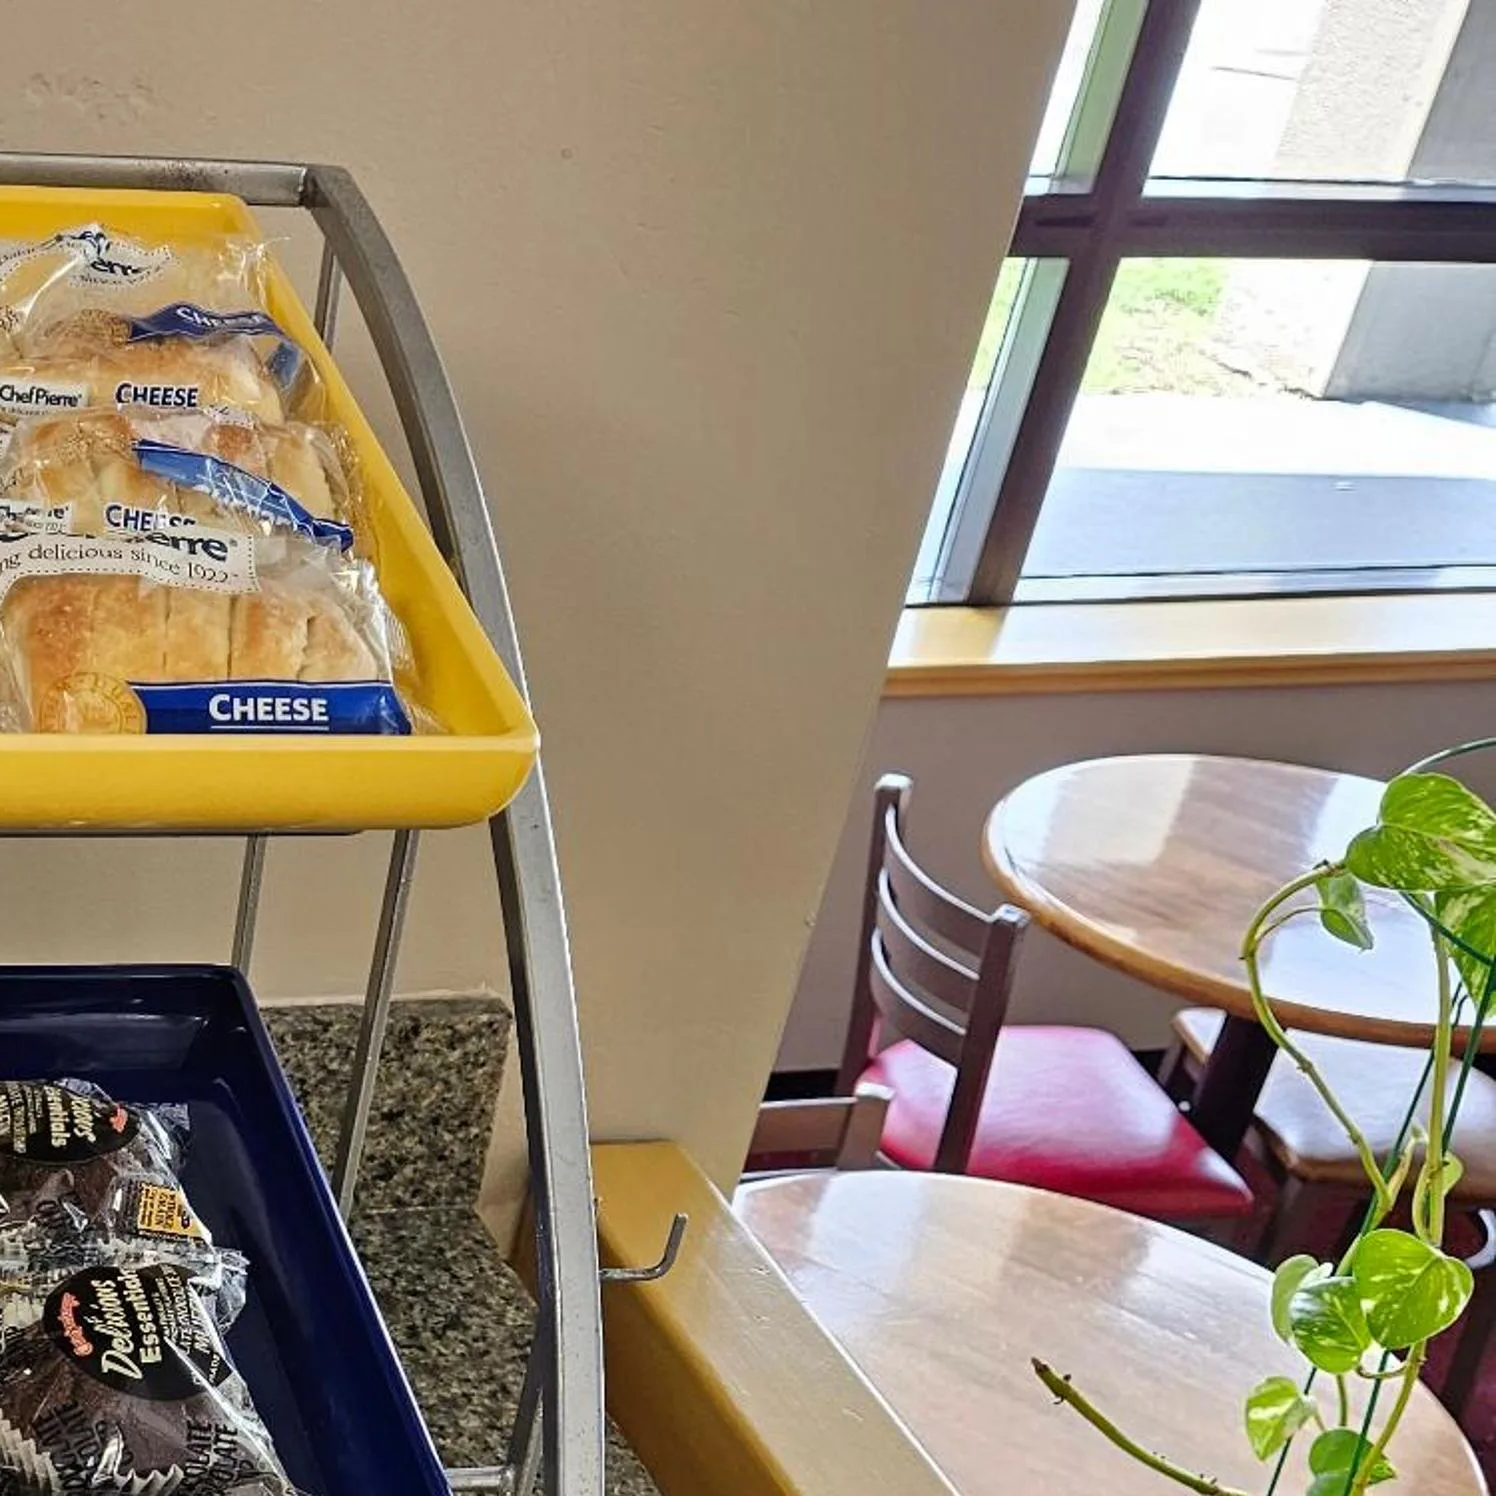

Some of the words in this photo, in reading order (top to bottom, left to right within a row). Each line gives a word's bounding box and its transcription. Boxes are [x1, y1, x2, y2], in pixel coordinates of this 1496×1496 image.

[0, 384, 78, 407] ChefPierre
[115, 383, 197, 407] CHEESE
[28, 544, 122, 561] delicious
[131, 549, 180, 576] since
[209, 694, 329, 722] CHEESE
[90, 1279, 143, 1380] Delicious
